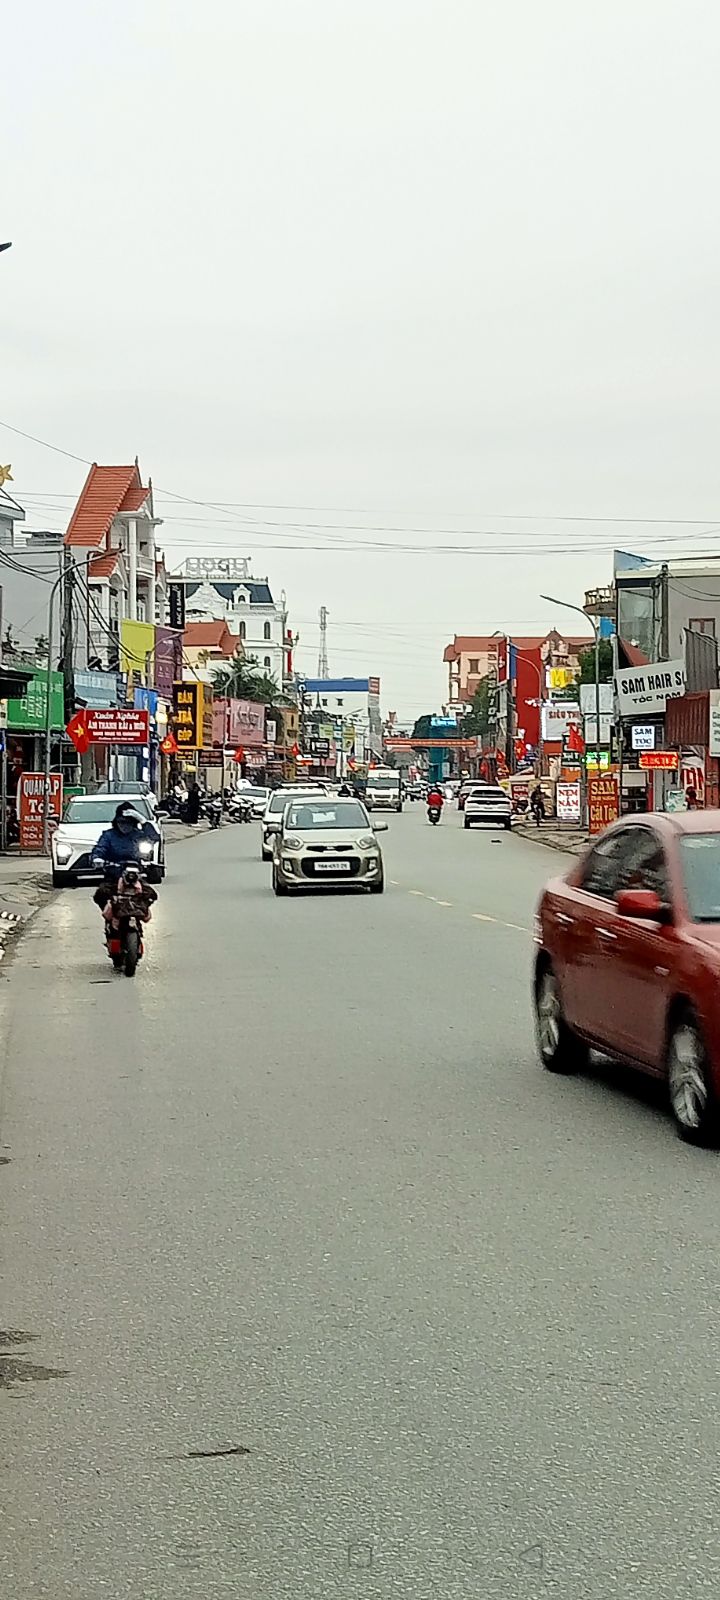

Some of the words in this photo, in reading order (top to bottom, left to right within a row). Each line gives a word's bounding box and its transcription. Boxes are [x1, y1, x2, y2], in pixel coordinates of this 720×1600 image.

[621, 677, 646, 695] SAM
[647, 672, 673, 691] HAIR
[674, 671, 685, 686] S
[177, 690, 193, 704] BÁN
[591, 781, 616, 795] SAM
